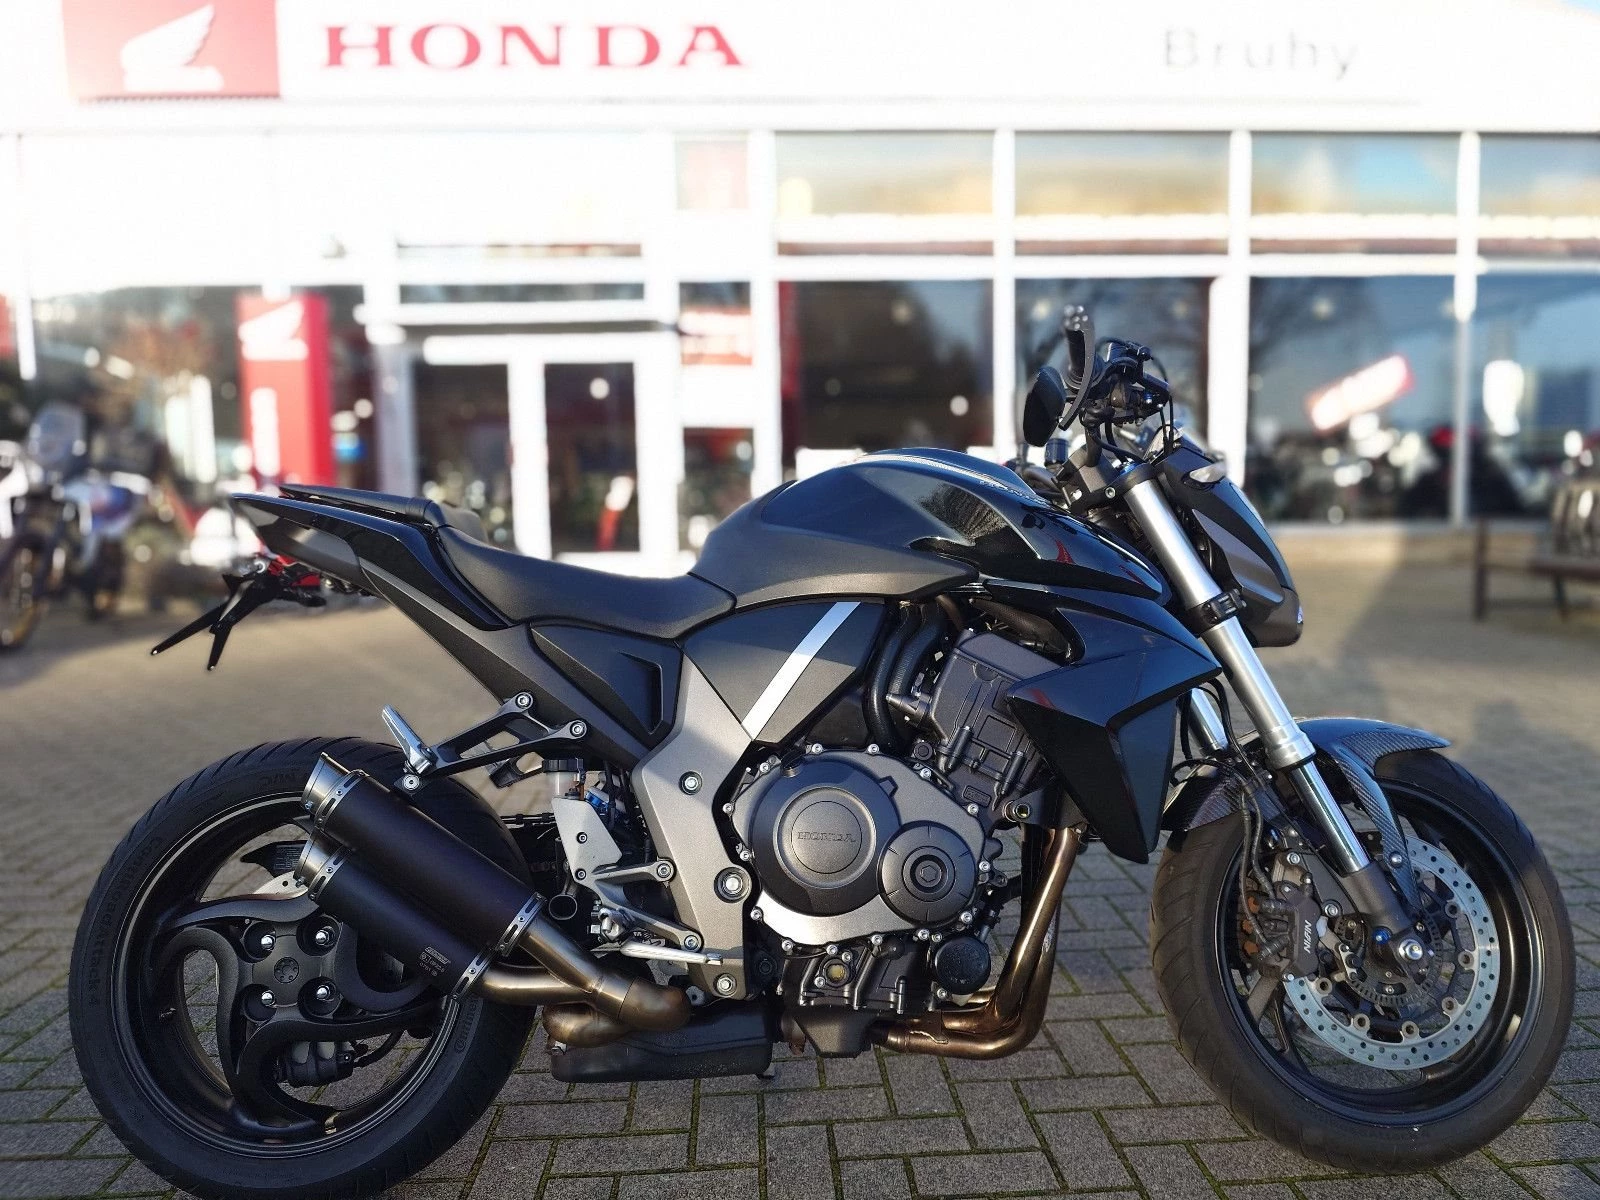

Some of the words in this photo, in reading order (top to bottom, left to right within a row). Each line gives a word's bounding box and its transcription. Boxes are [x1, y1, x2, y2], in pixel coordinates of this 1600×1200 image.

[325, 24, 742, 67] HONDA
[1163, 26, 1358, 80] Bruhy
[797, 831, 857, 843] HONDA
